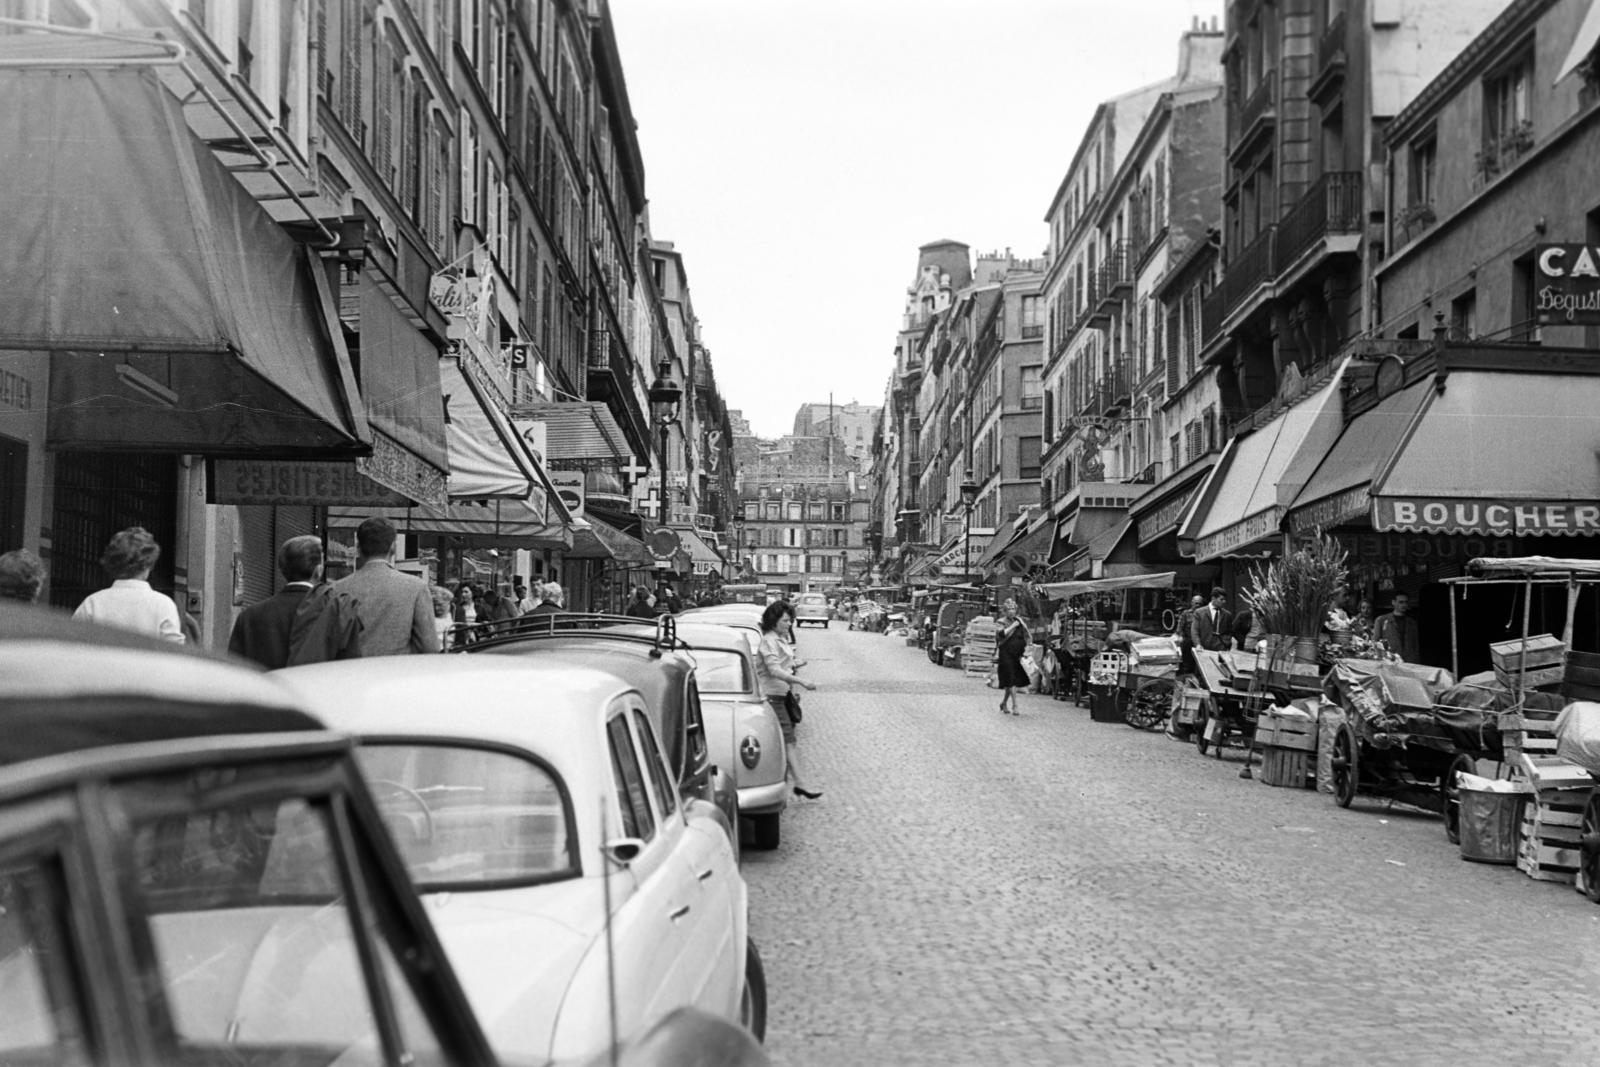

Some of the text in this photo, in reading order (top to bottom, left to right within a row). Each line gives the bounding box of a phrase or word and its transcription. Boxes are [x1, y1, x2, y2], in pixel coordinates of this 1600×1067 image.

[1539, 246, 1600, 277] CA
[514, 349, 524, 364] S
[1393, 501, 1600, 529] BOUCHER
